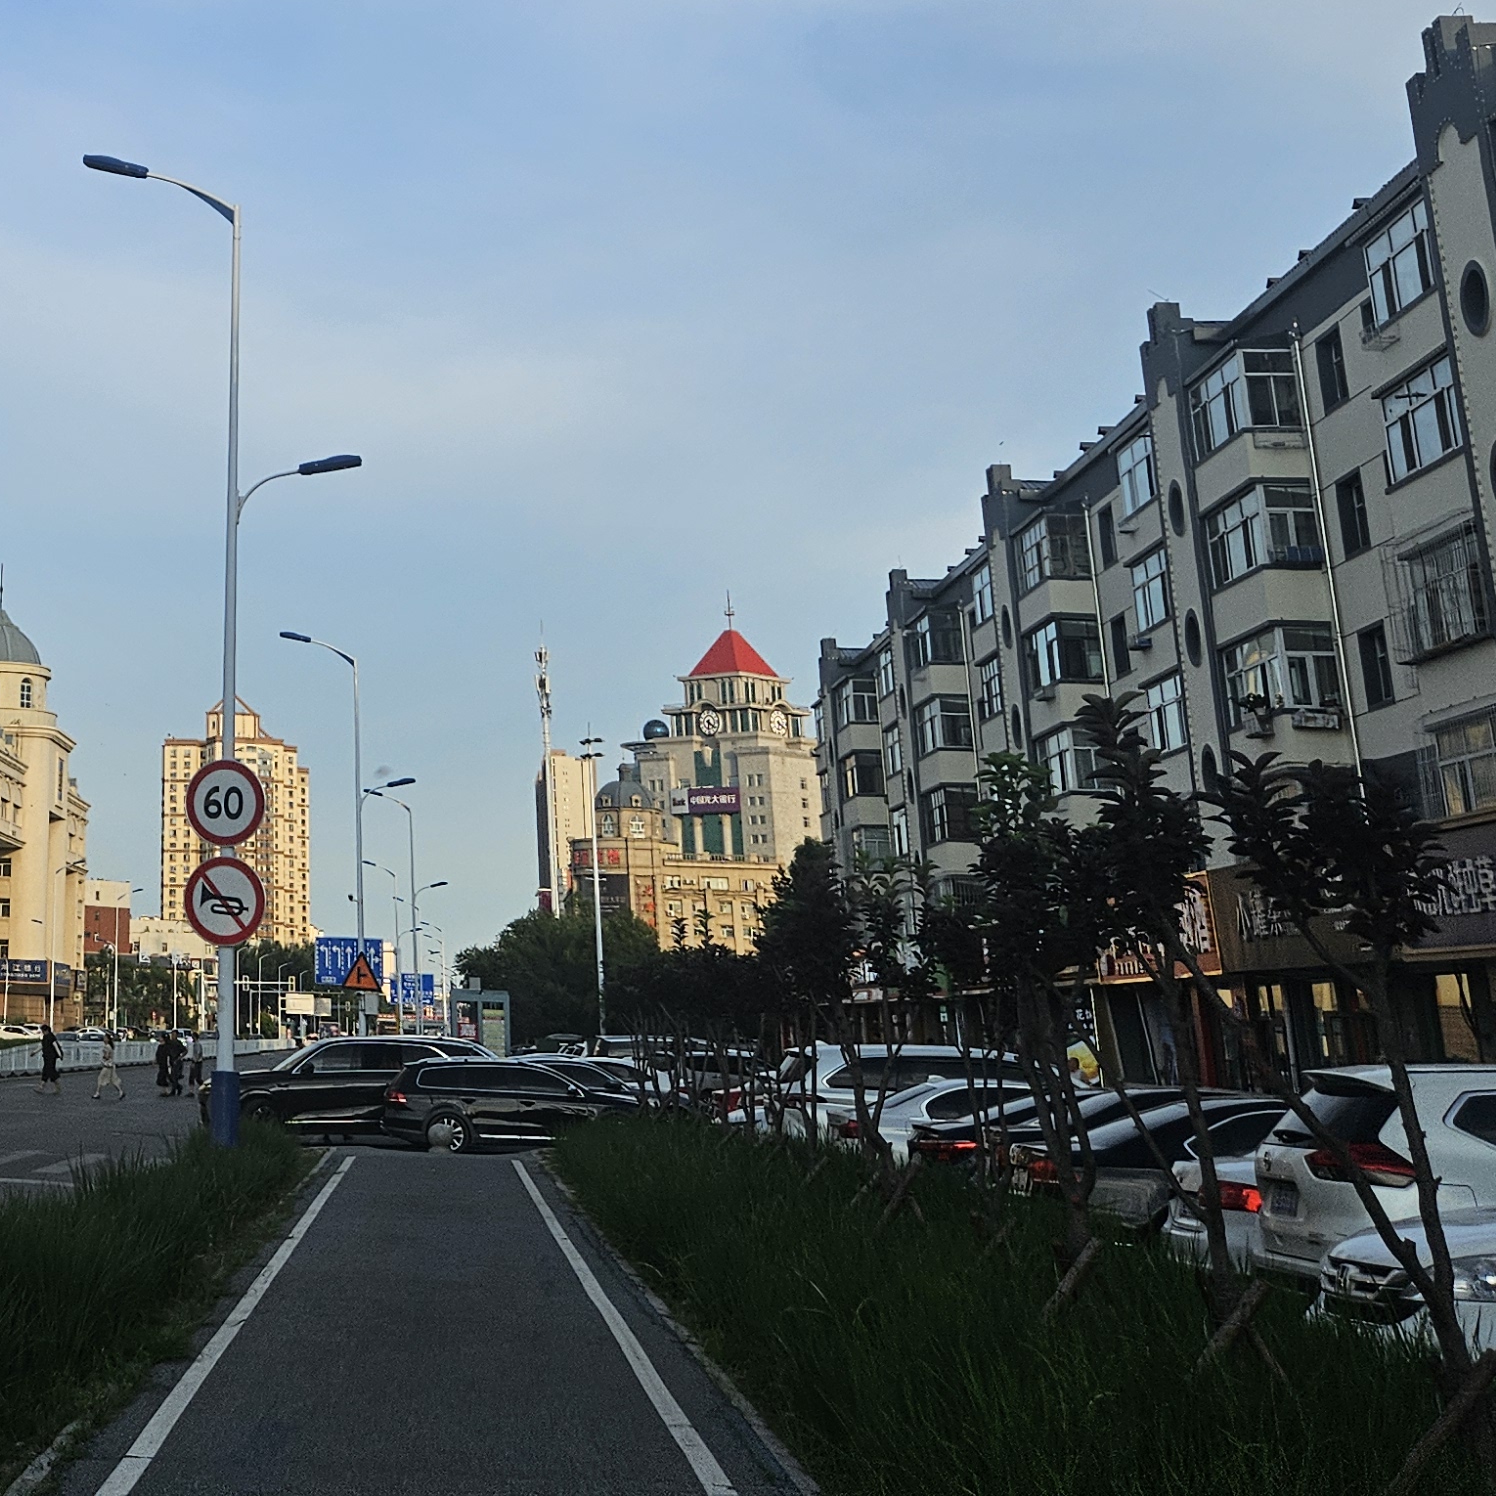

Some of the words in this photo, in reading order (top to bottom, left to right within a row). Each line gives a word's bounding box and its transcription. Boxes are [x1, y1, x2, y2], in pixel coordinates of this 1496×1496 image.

[204, 785, 243, 820] 60
[690, 794, 736, 804] 中国光大银行
